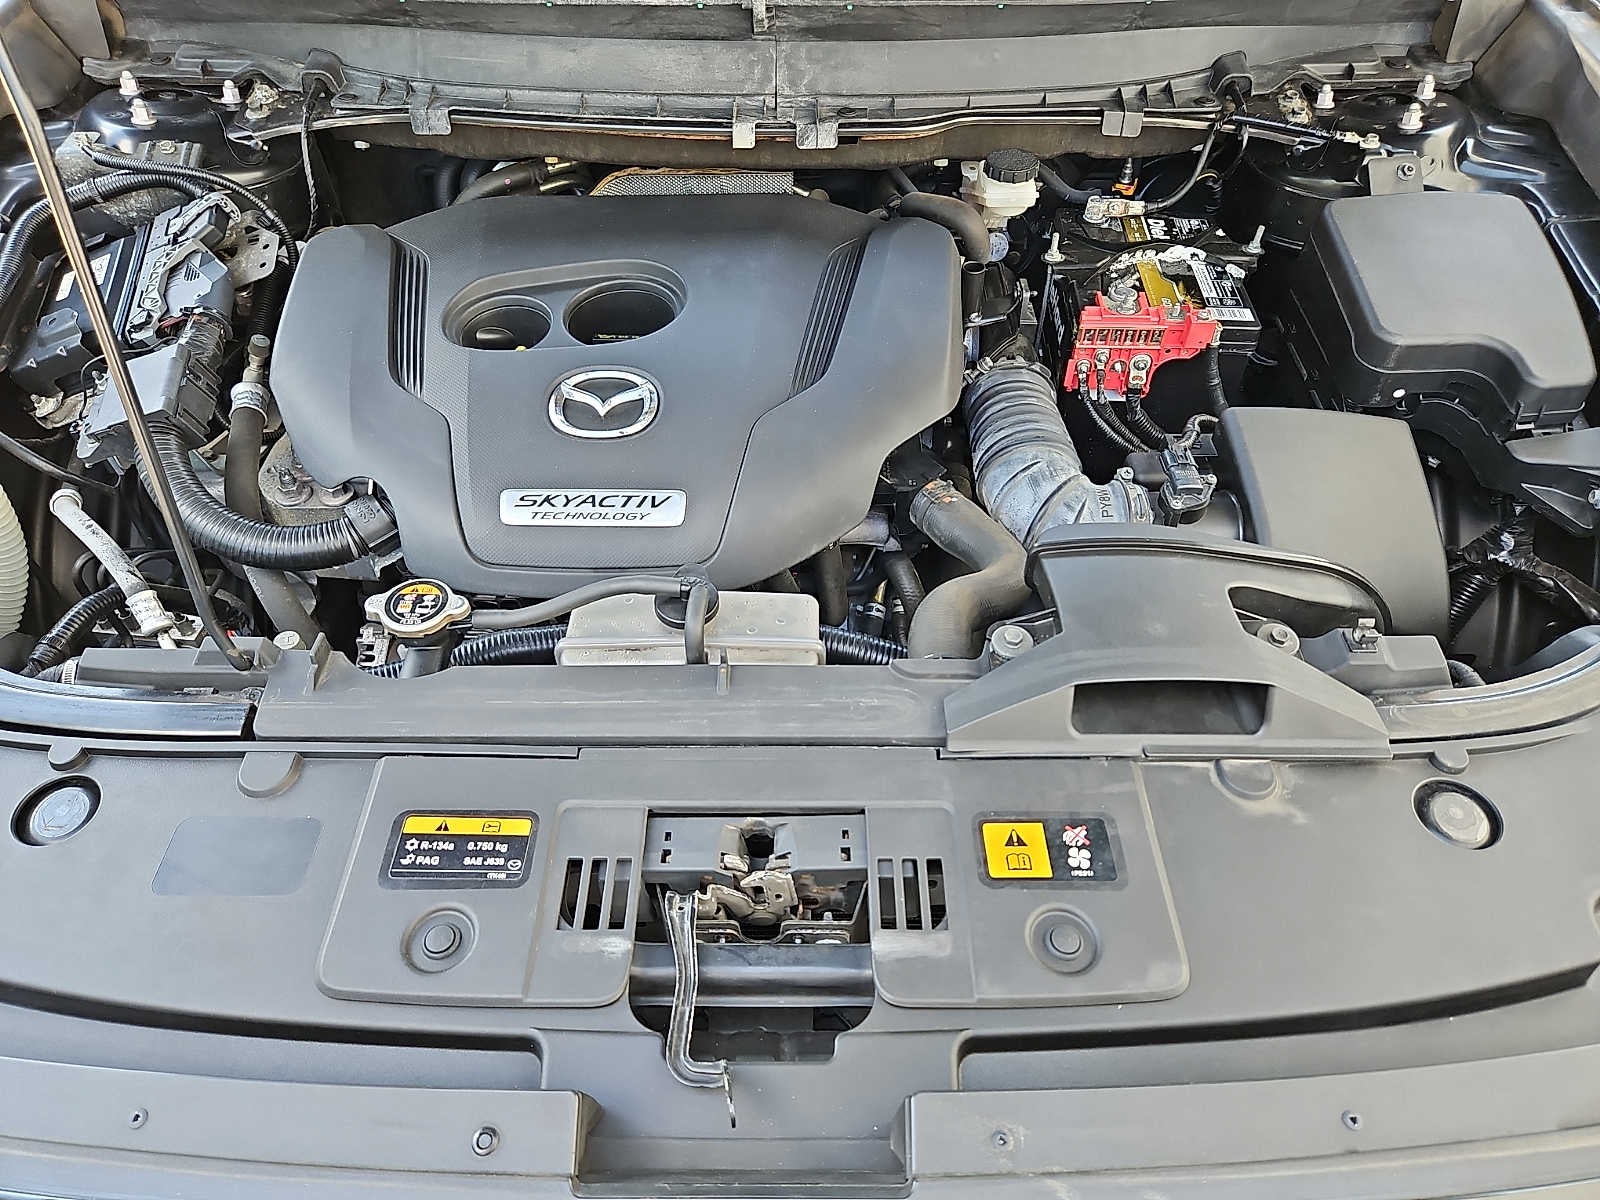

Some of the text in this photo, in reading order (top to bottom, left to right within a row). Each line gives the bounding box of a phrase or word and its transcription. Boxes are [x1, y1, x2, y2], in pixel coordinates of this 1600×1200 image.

[514, 494, 673, 509] SKYACTIV
[1095, 488, 1114, 518] PY8W
[531, 511, 652, 521] TECHNOLOGY
[420, 840, 508, 853] R-134a 0.750 kg
[415, 855, 440, 866] PAG
[463, 856, 483, 866] SAE
